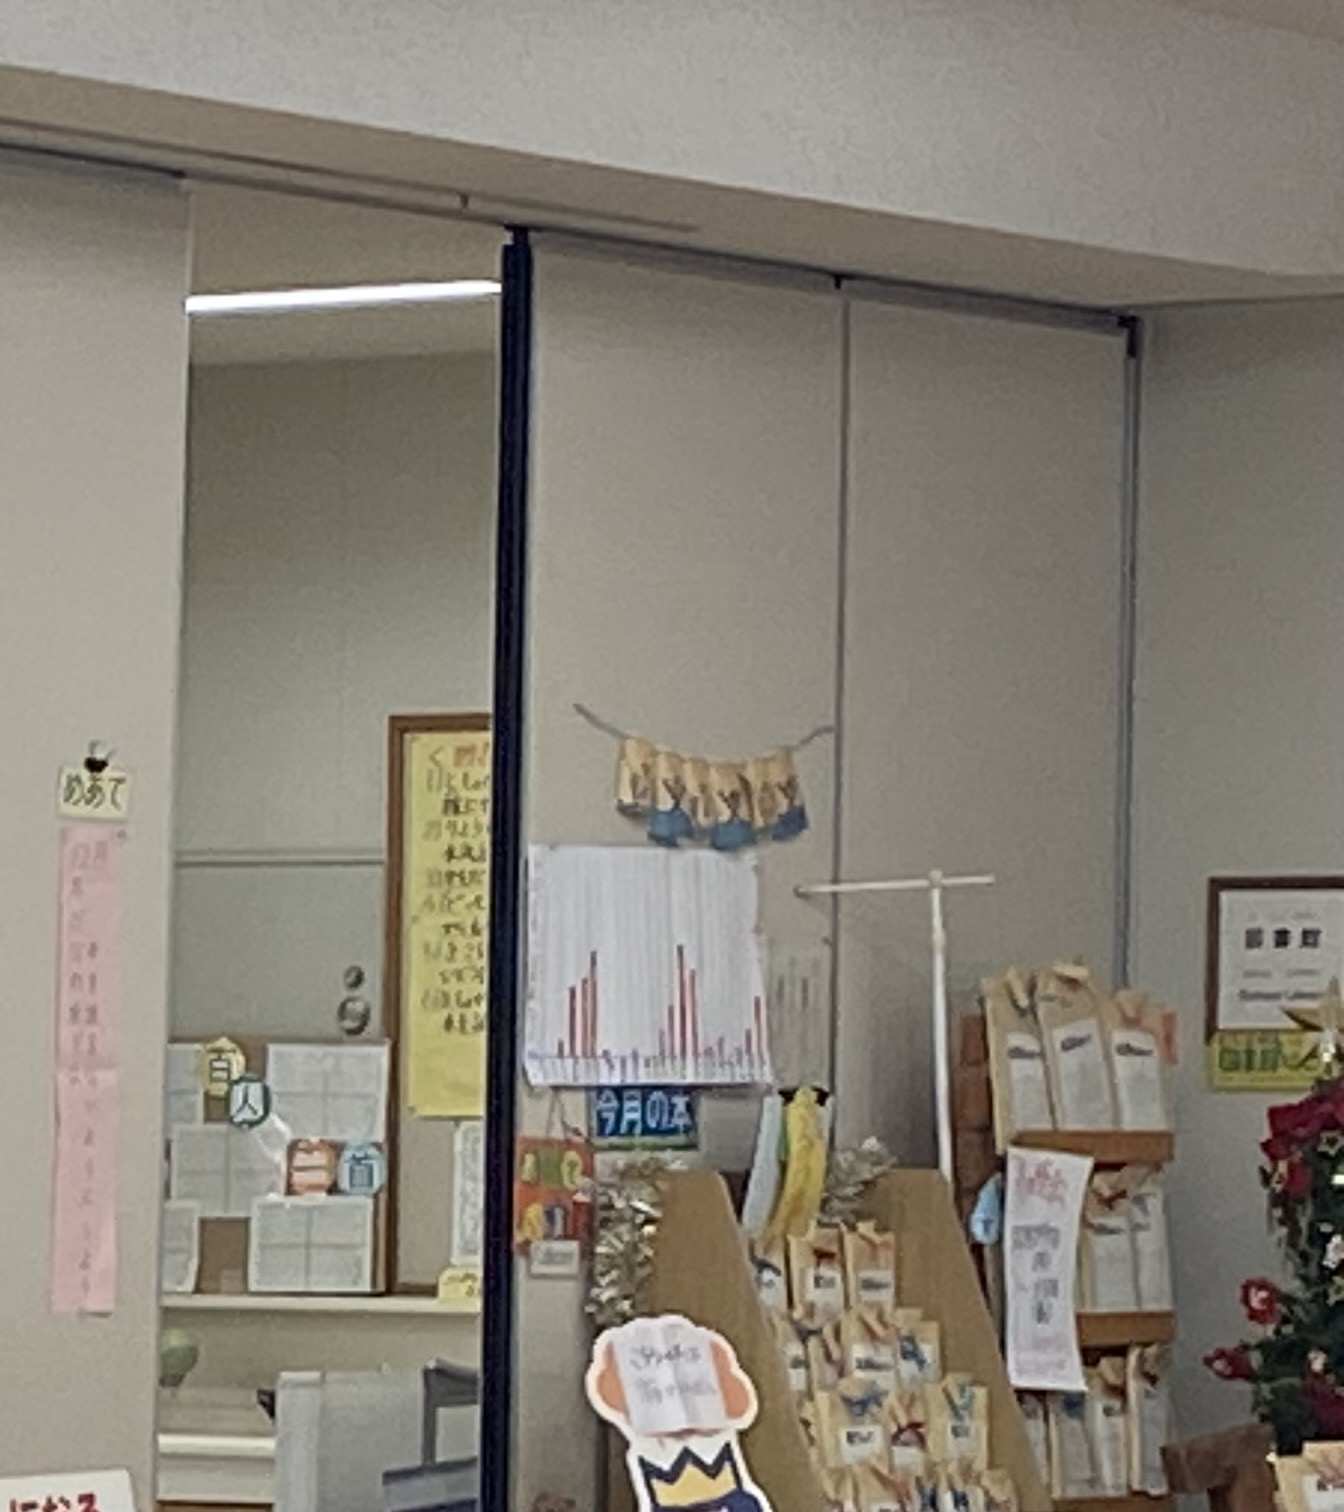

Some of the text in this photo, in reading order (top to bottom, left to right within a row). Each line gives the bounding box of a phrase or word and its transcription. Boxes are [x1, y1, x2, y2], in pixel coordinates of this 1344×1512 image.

[62, 773, 127, 812] めあて
[596, 1088, 693, 1136] 今月の本
